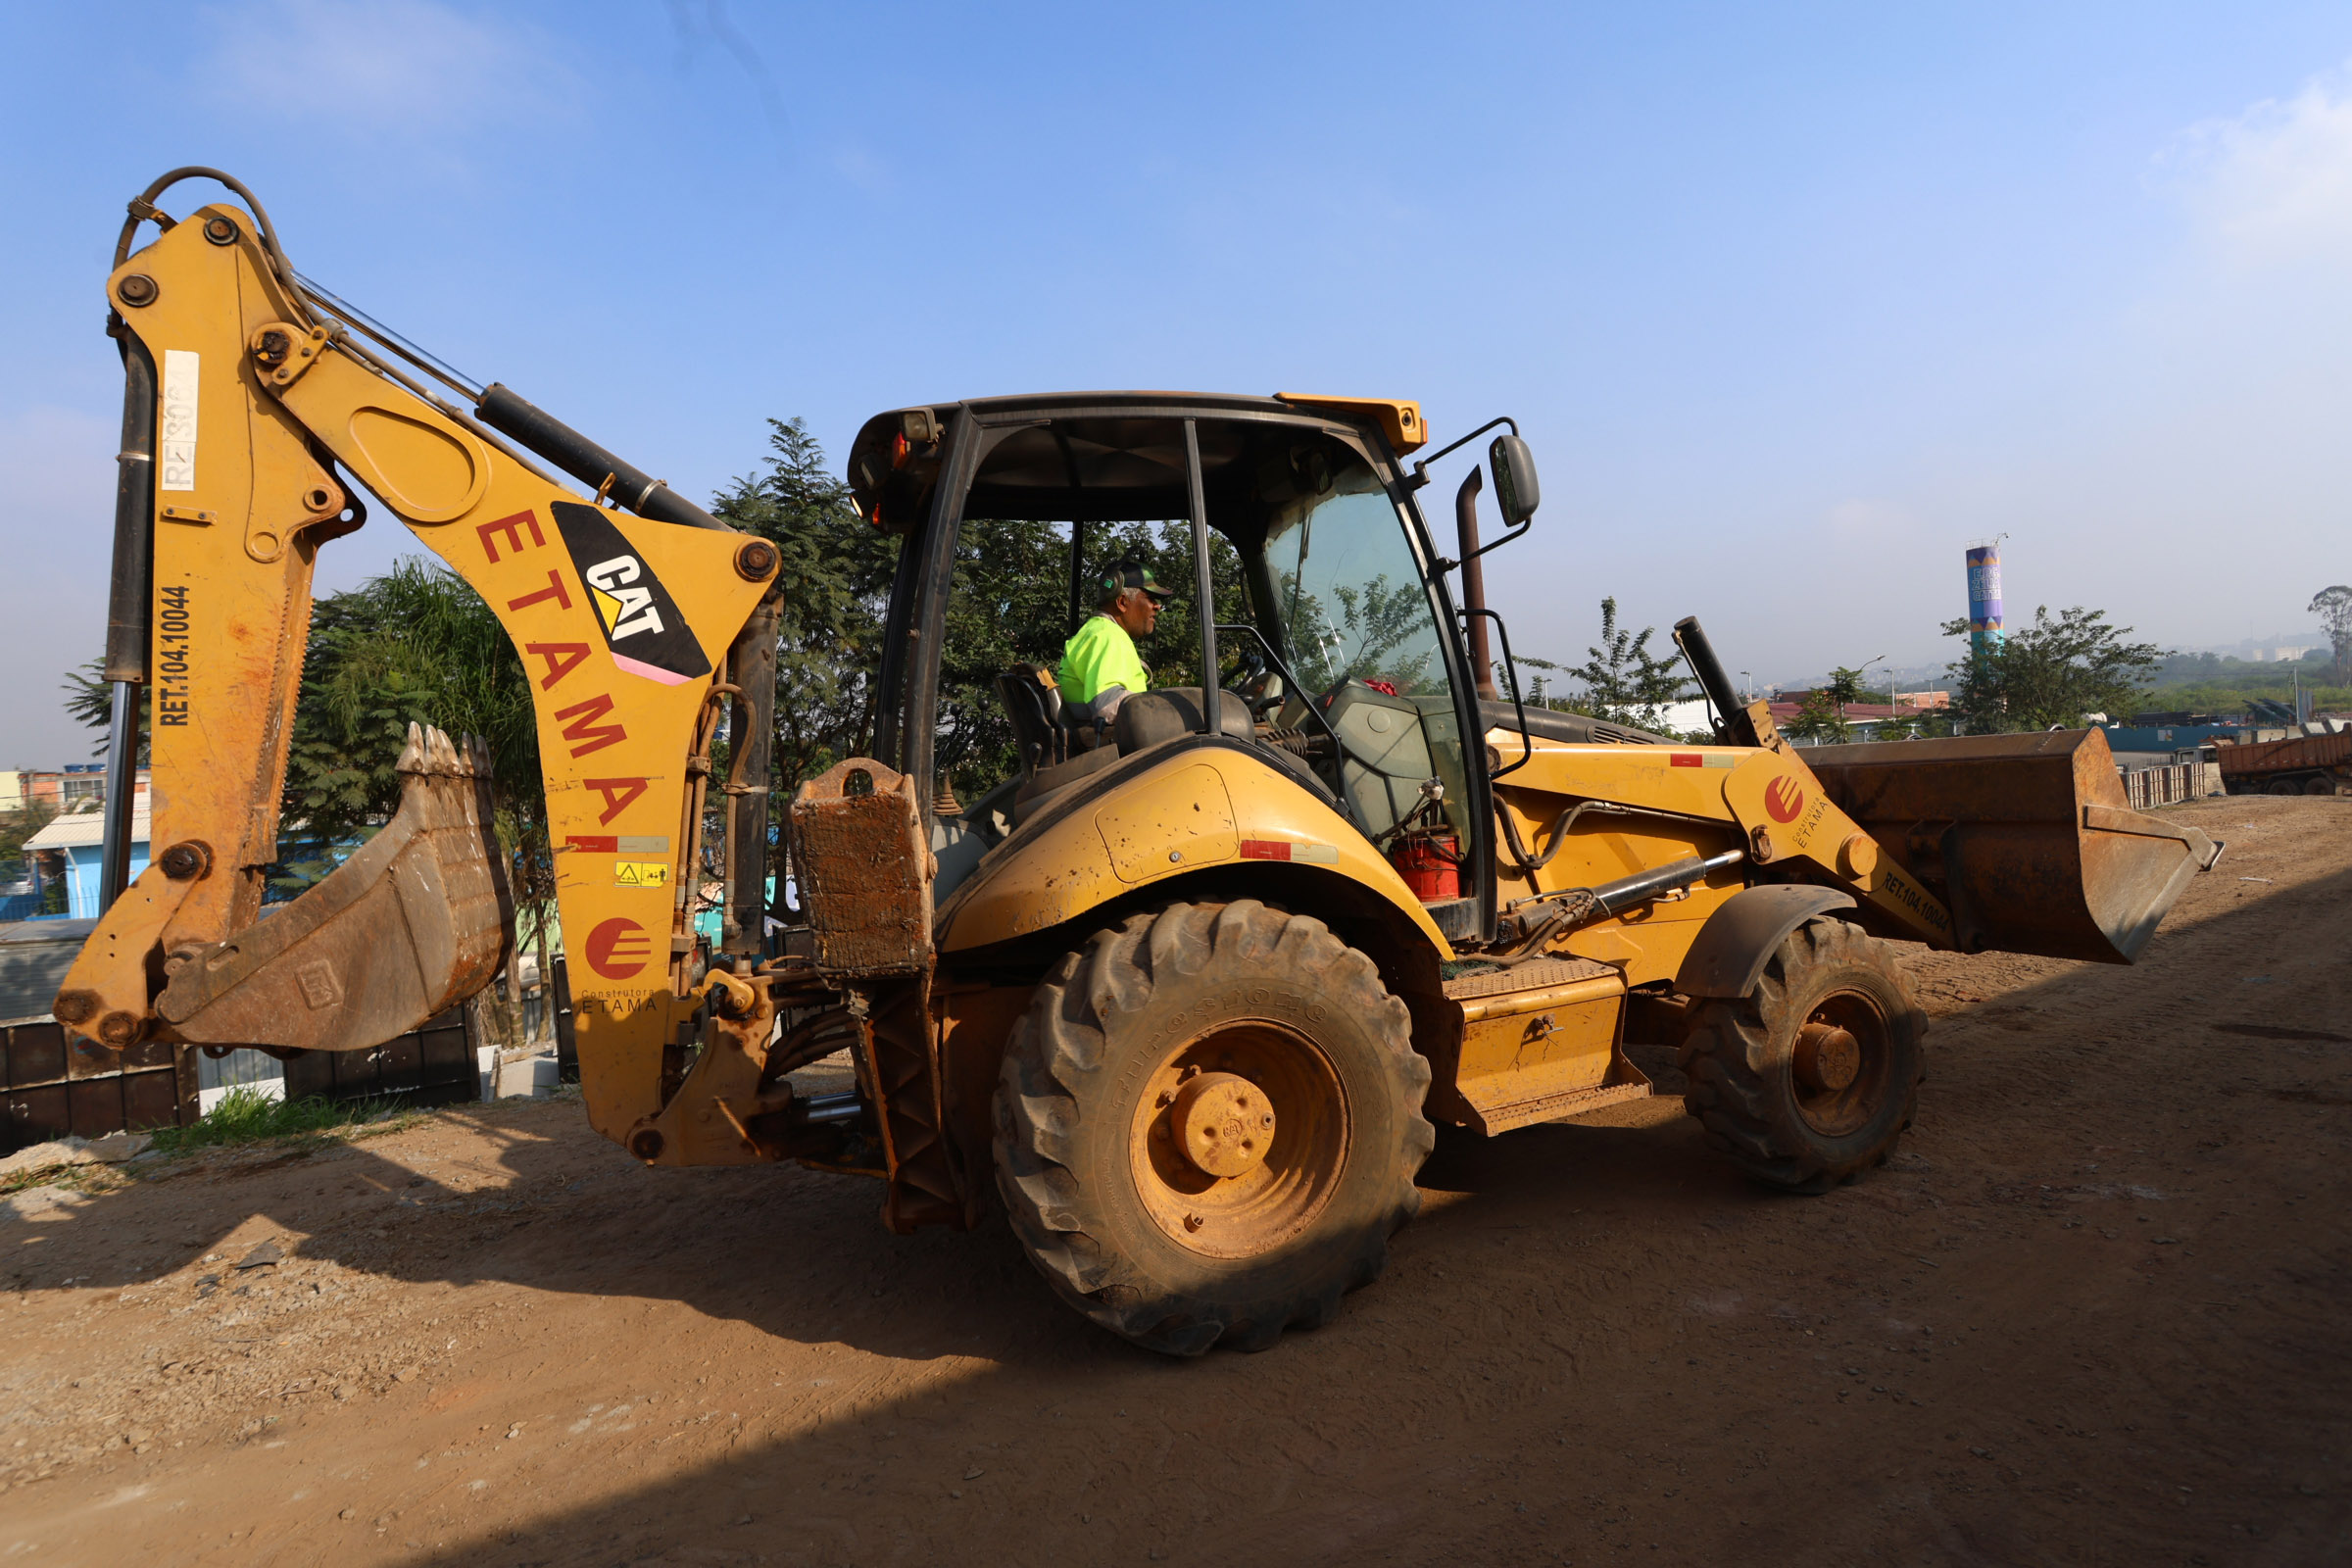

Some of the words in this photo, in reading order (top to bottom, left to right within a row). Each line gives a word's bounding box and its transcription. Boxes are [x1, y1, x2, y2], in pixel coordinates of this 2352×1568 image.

[586, 555, 664, 642] CAT
[160, 586, 189, 726] RET.104.10044
[475, 509, 649, 827] ETAMA
[1791, 797, 1820, 843] Construtora
[1796, 801, 1829, 849] ETAMA
[1883, 871, 1949, 932] RET.104.10044
[581, 988, 656, 999] Construtora
[582, 998, 659, 1014] ETAMA
